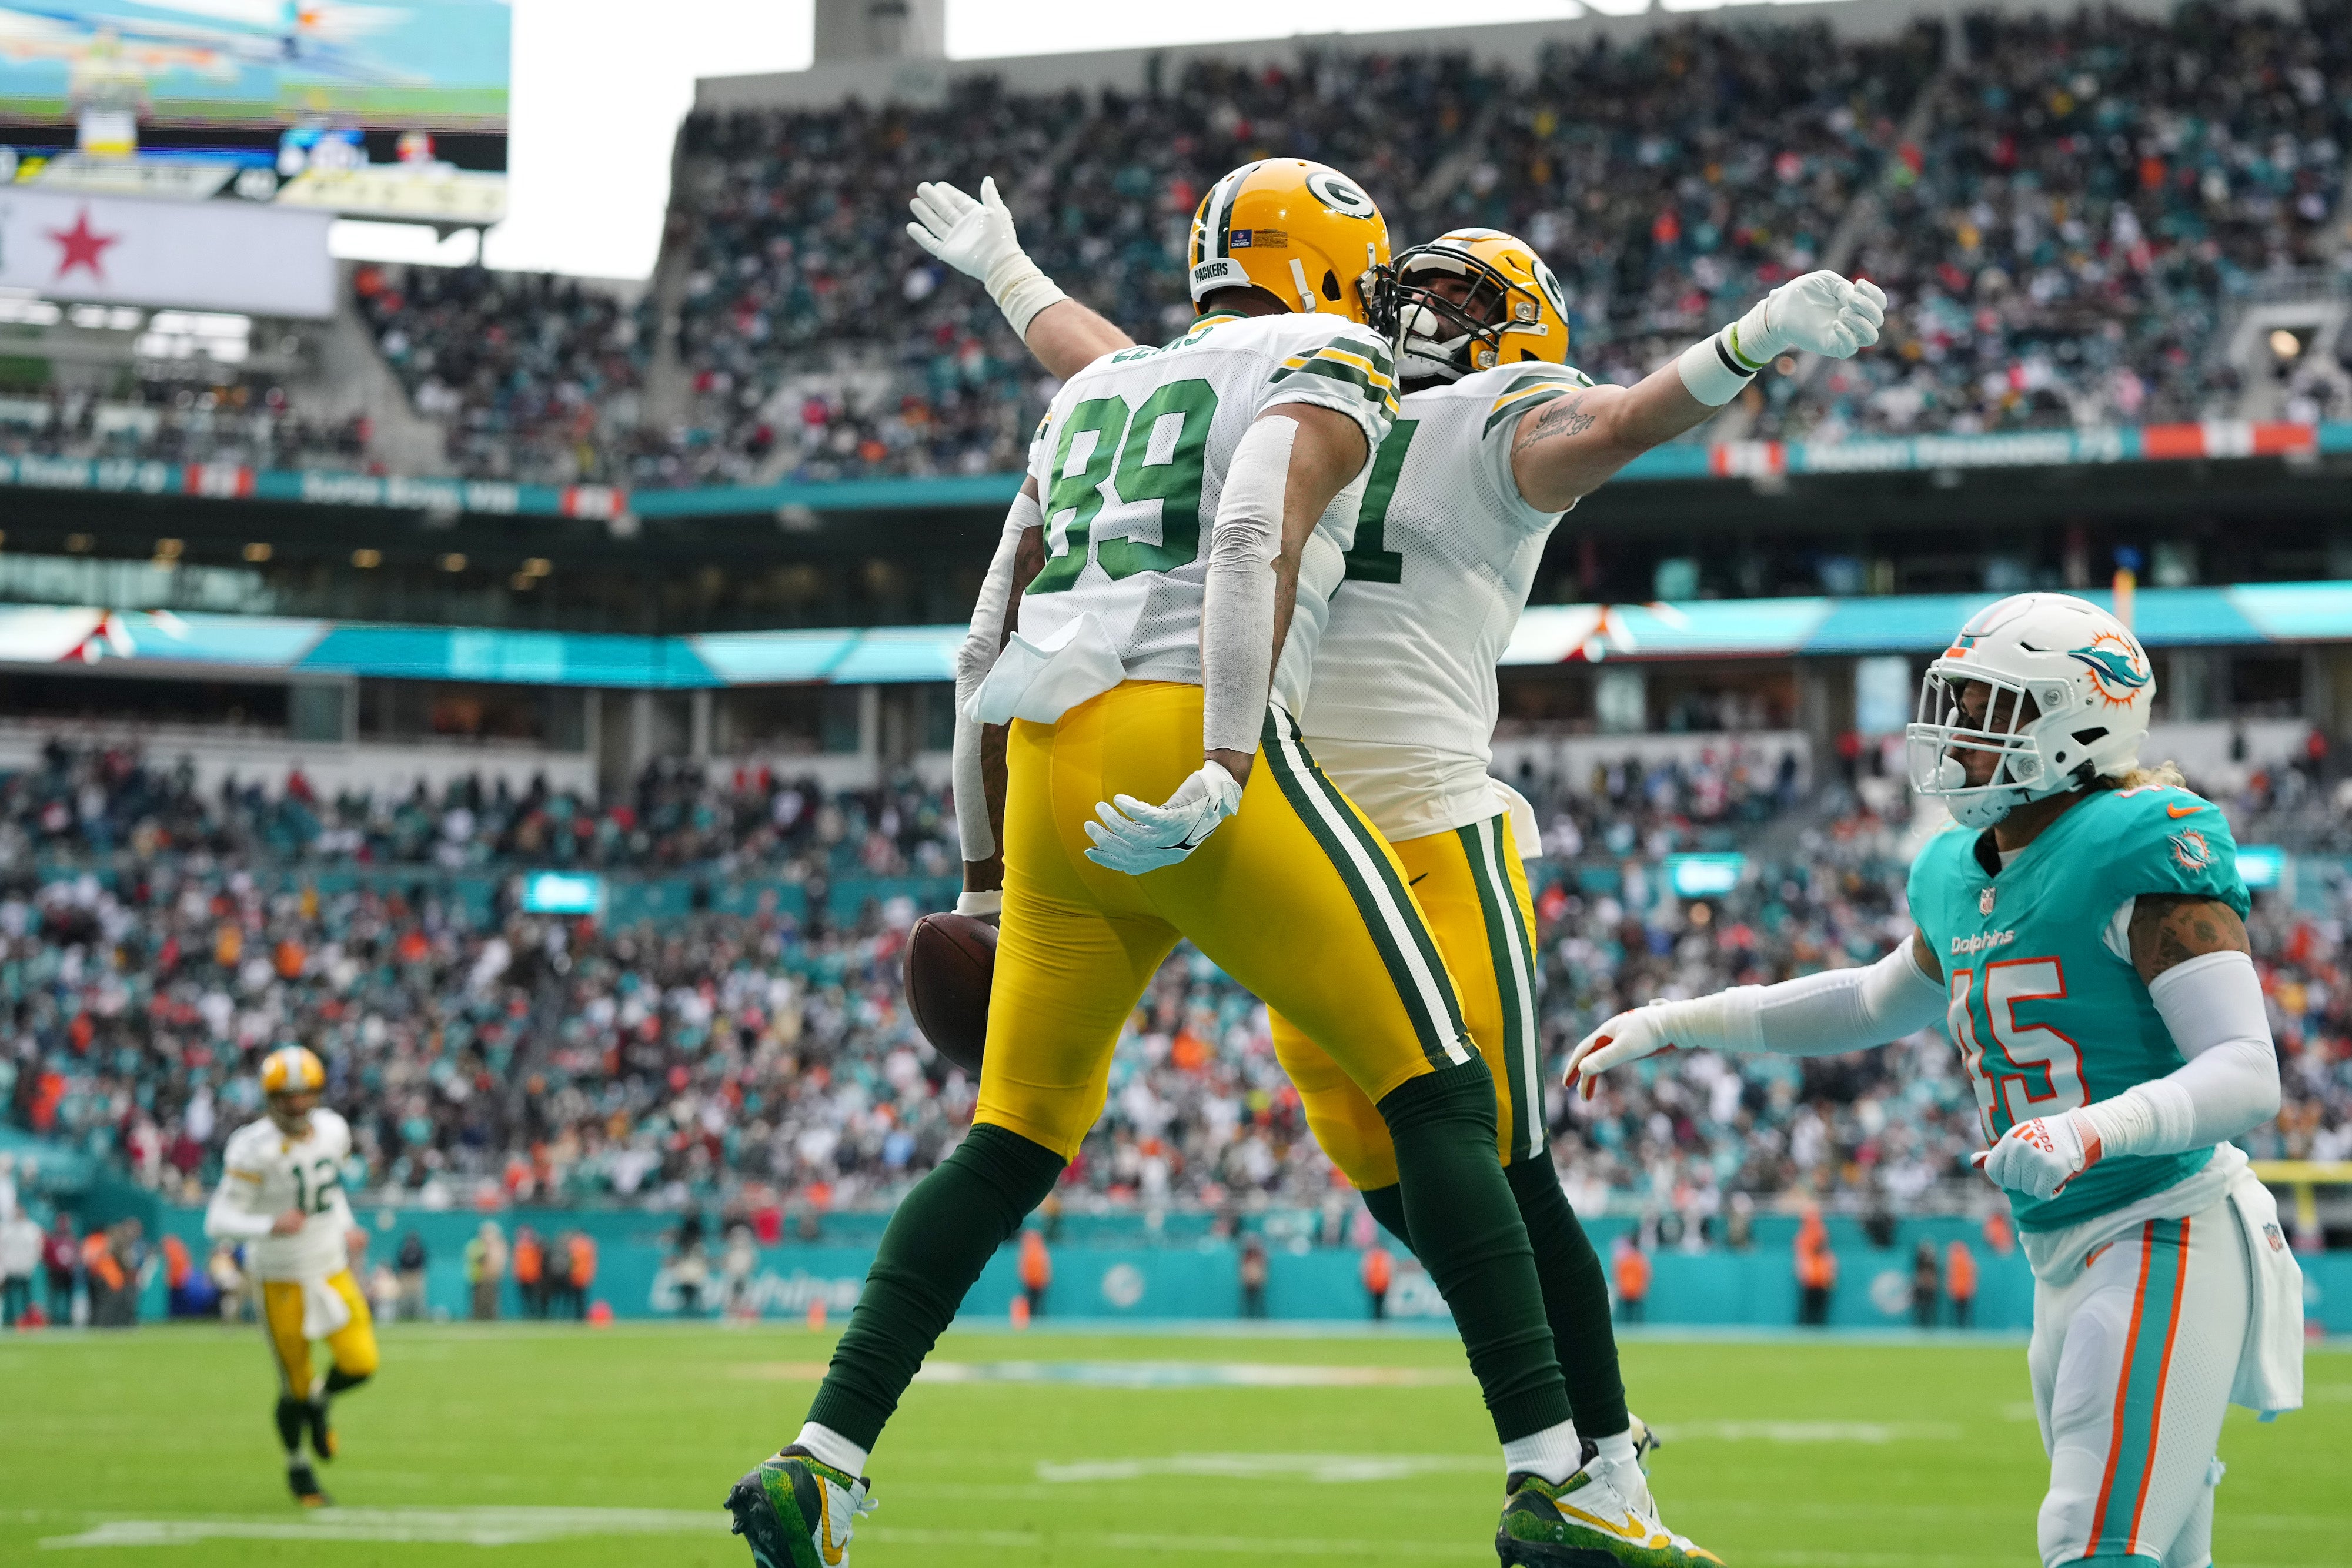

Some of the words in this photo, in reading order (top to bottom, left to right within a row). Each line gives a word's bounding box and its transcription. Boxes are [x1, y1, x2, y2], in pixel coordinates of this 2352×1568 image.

[1194, 262, 1228, 283] PACKERS
[1025, 378, 1219, 595] 89
[1328, 419, 1420, 603] 1
[1951, 929, 2016, 957] Dolphins
[1947, 955, 2091, 1150] 45
[290, 1156, 346, 1213] 12
